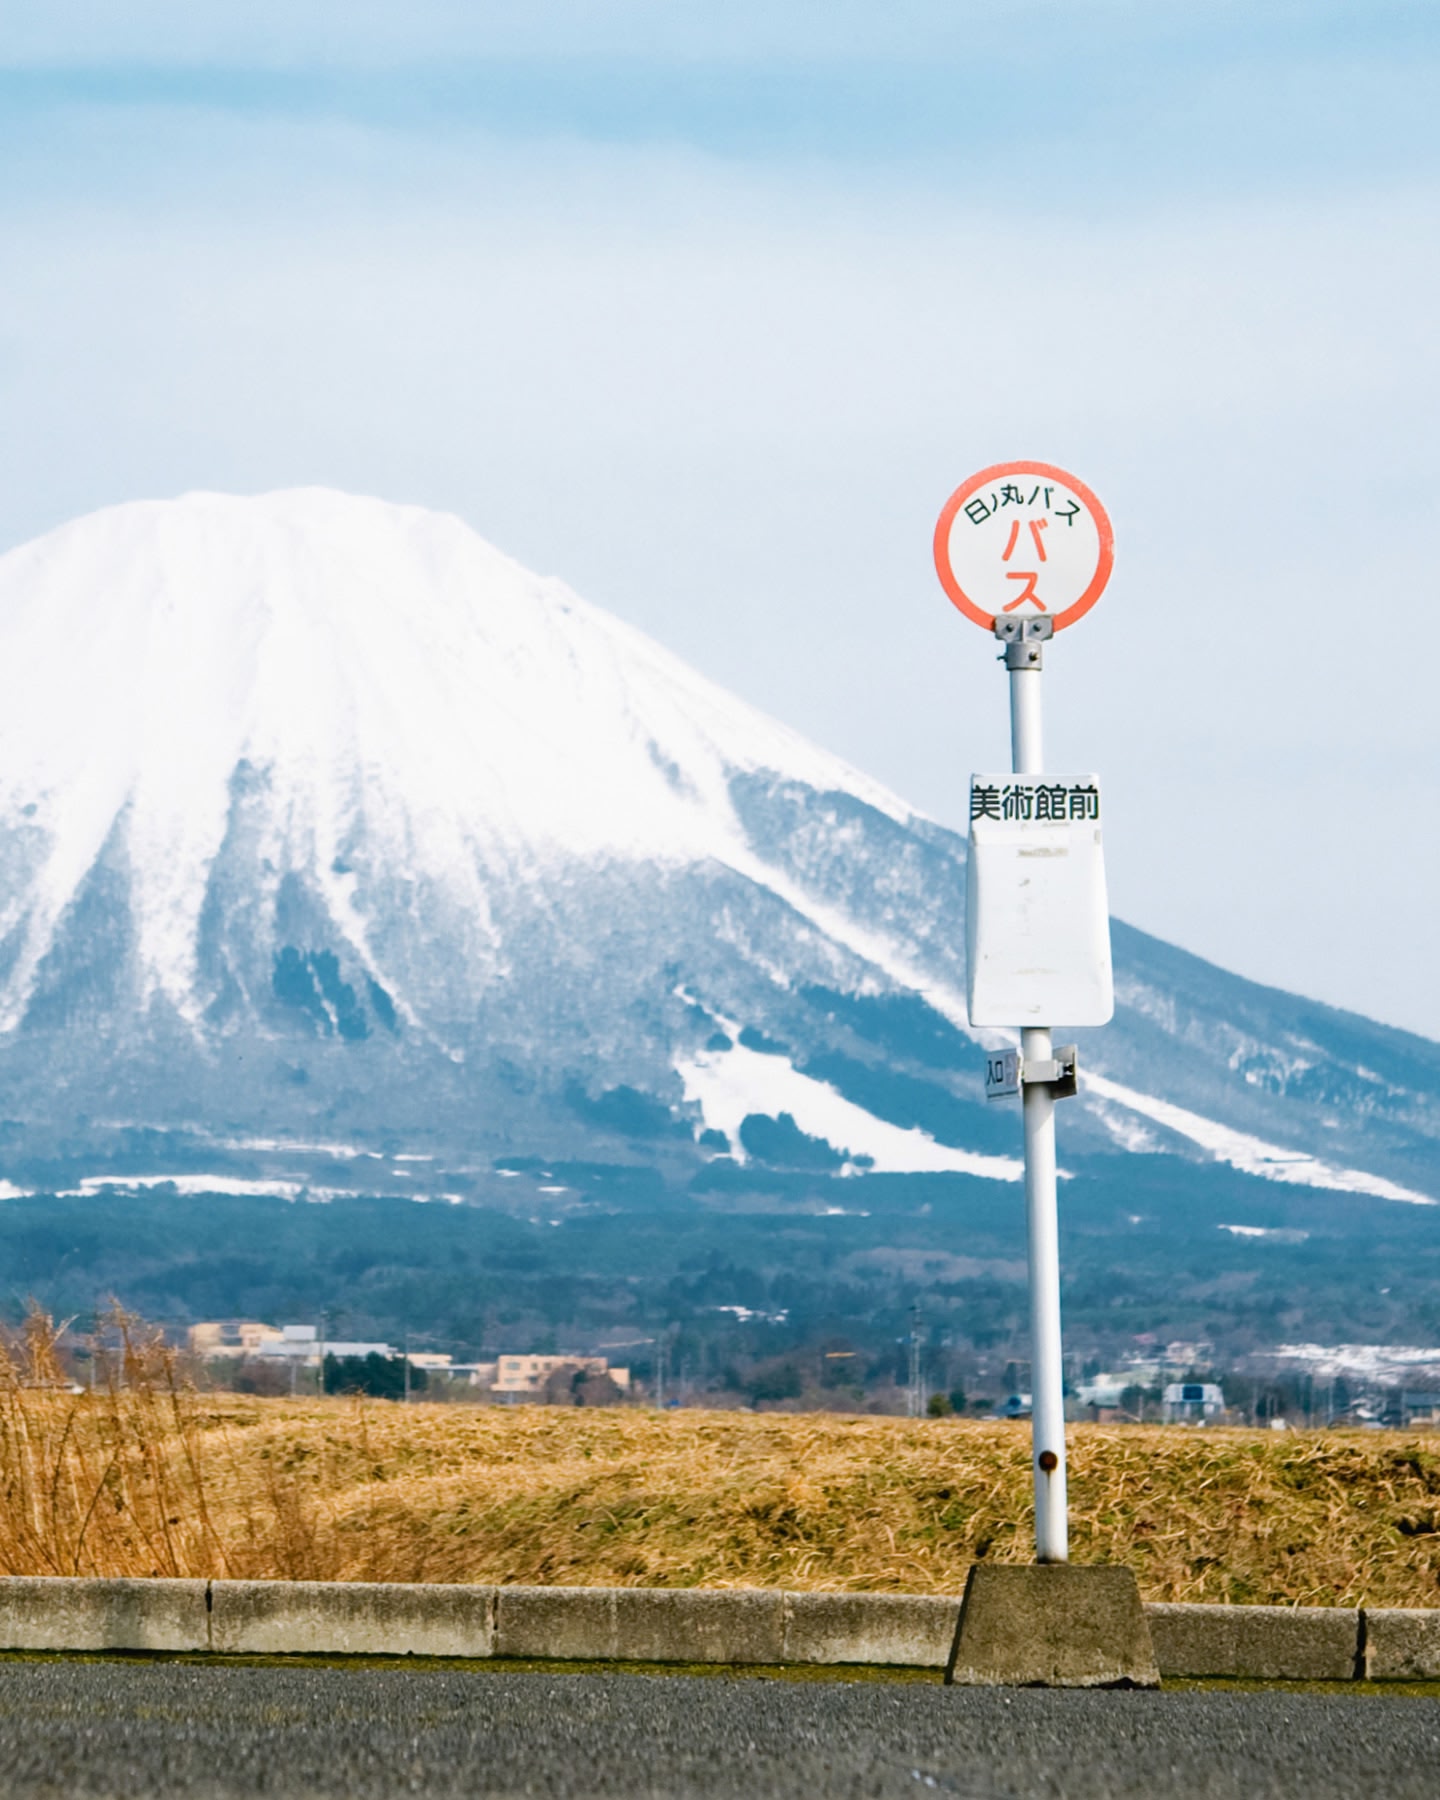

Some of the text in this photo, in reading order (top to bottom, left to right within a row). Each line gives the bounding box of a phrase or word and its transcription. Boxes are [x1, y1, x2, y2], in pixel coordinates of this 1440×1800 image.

[964, 484, 1081, 527] 日ノ丸バス
[1001, 518, 1048, 613] バス
[970, 784, 1099, 821] 美術館前
